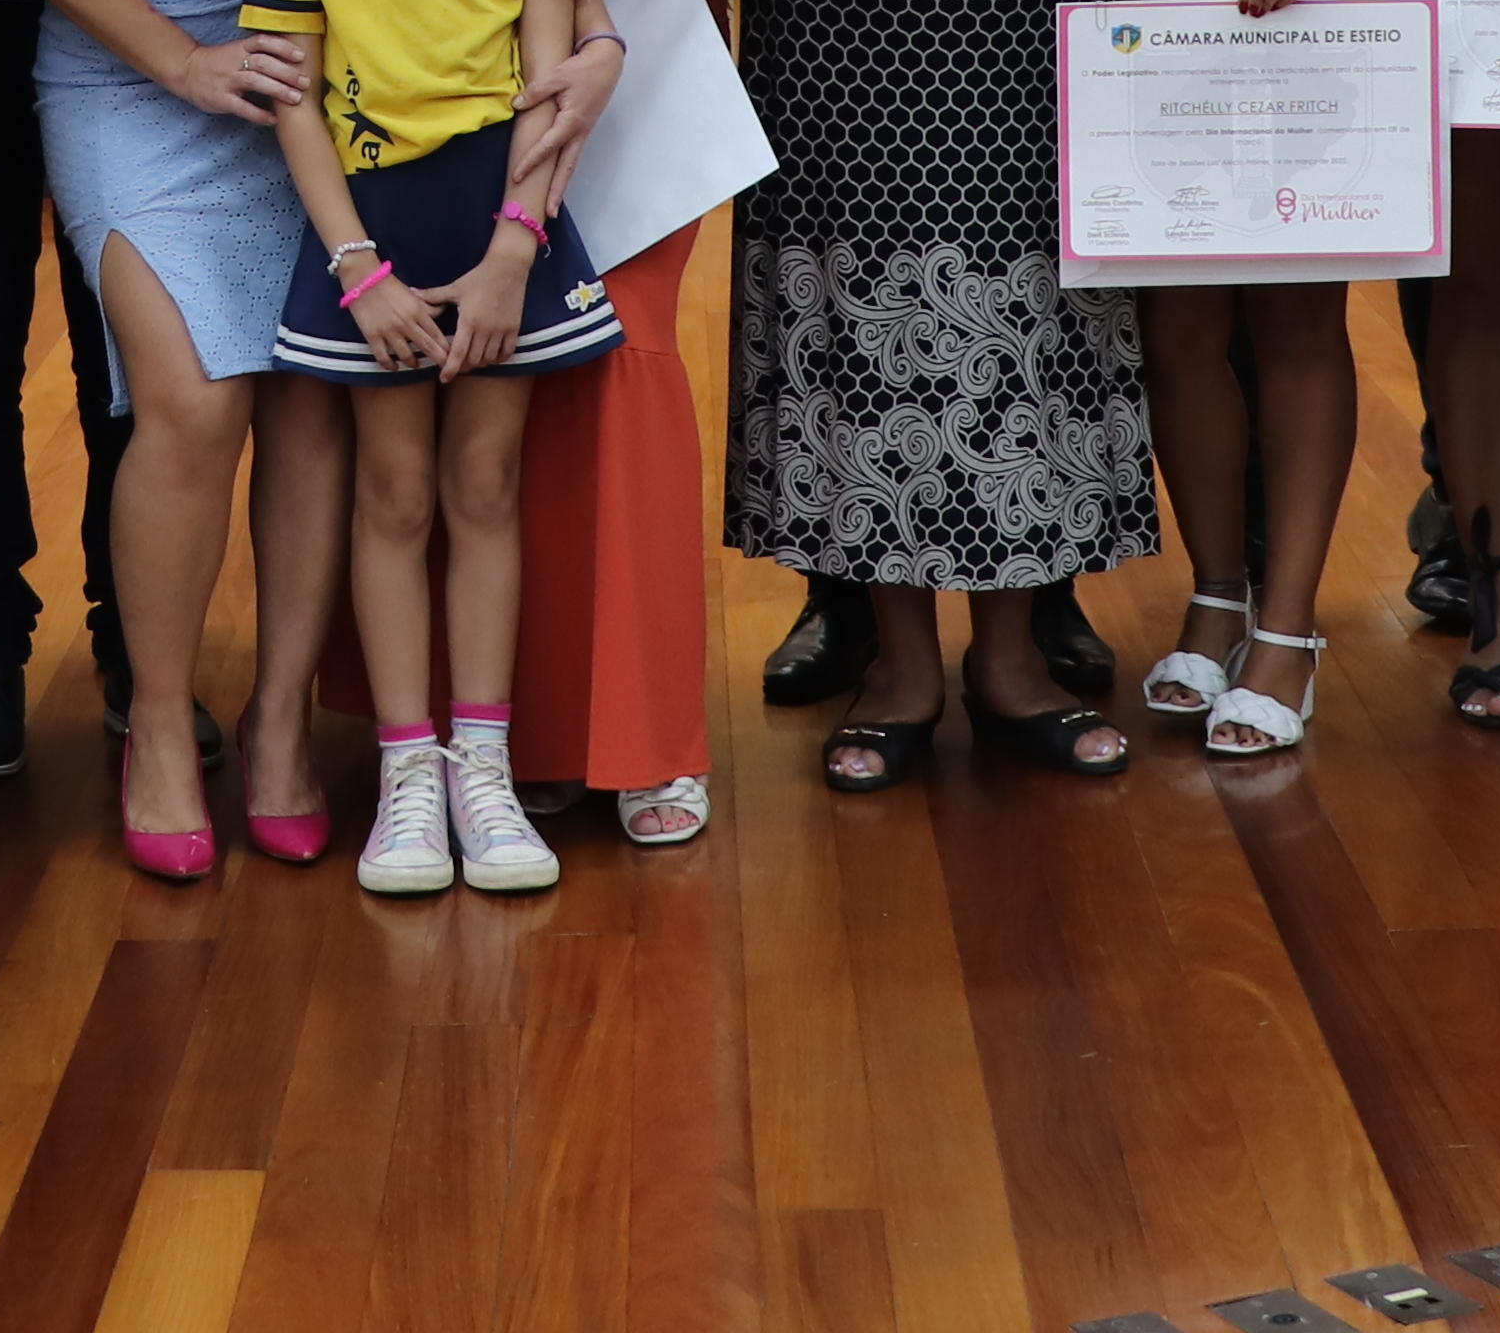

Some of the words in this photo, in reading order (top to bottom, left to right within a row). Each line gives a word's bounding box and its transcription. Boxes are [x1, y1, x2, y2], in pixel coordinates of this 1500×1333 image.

[1149, 28, 1224, 46] CÂMARA
[1229, 29, 1319, 45] MUNICIPAL
[1324, 29, 1344, 43] DE
[1349, 28, 1401, 43] ESTEIO
[1236, 100, 1285, 113] CEZAR
[1289, 99, 1338, 112] FRITCH
[1301, 200, 1381, 222] Mulher
